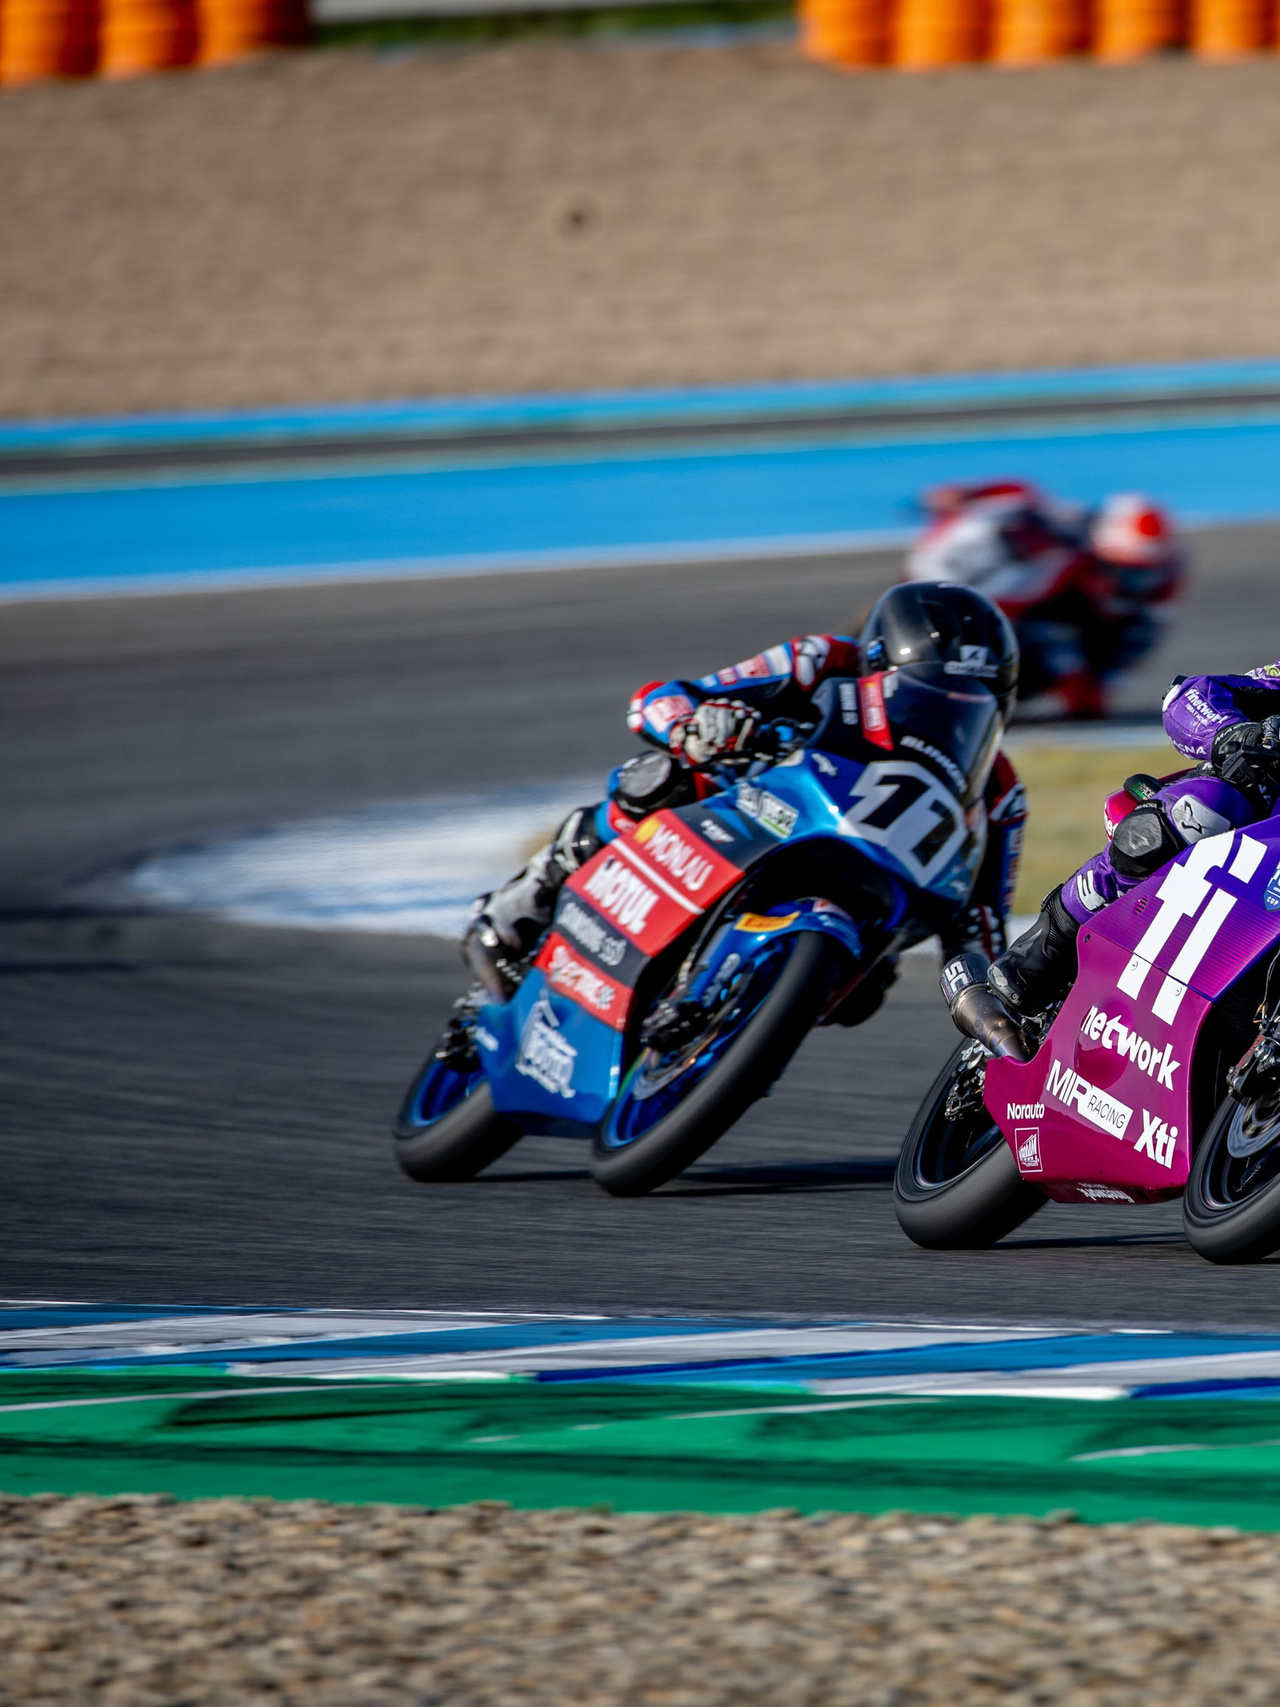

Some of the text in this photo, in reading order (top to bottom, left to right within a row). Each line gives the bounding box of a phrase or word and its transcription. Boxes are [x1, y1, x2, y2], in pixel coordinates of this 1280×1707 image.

[583, 860, 659, 935] MOTUL
[1266, 896, 1279, 906] CUP
[1080, 1005, 1181, 1091] network
[1007, 1102, 1045, 1120] Norauto
[1046, 1059, 1127, 1130] MIR RACING
[1133, 1108, 1179, 1170] Xti
